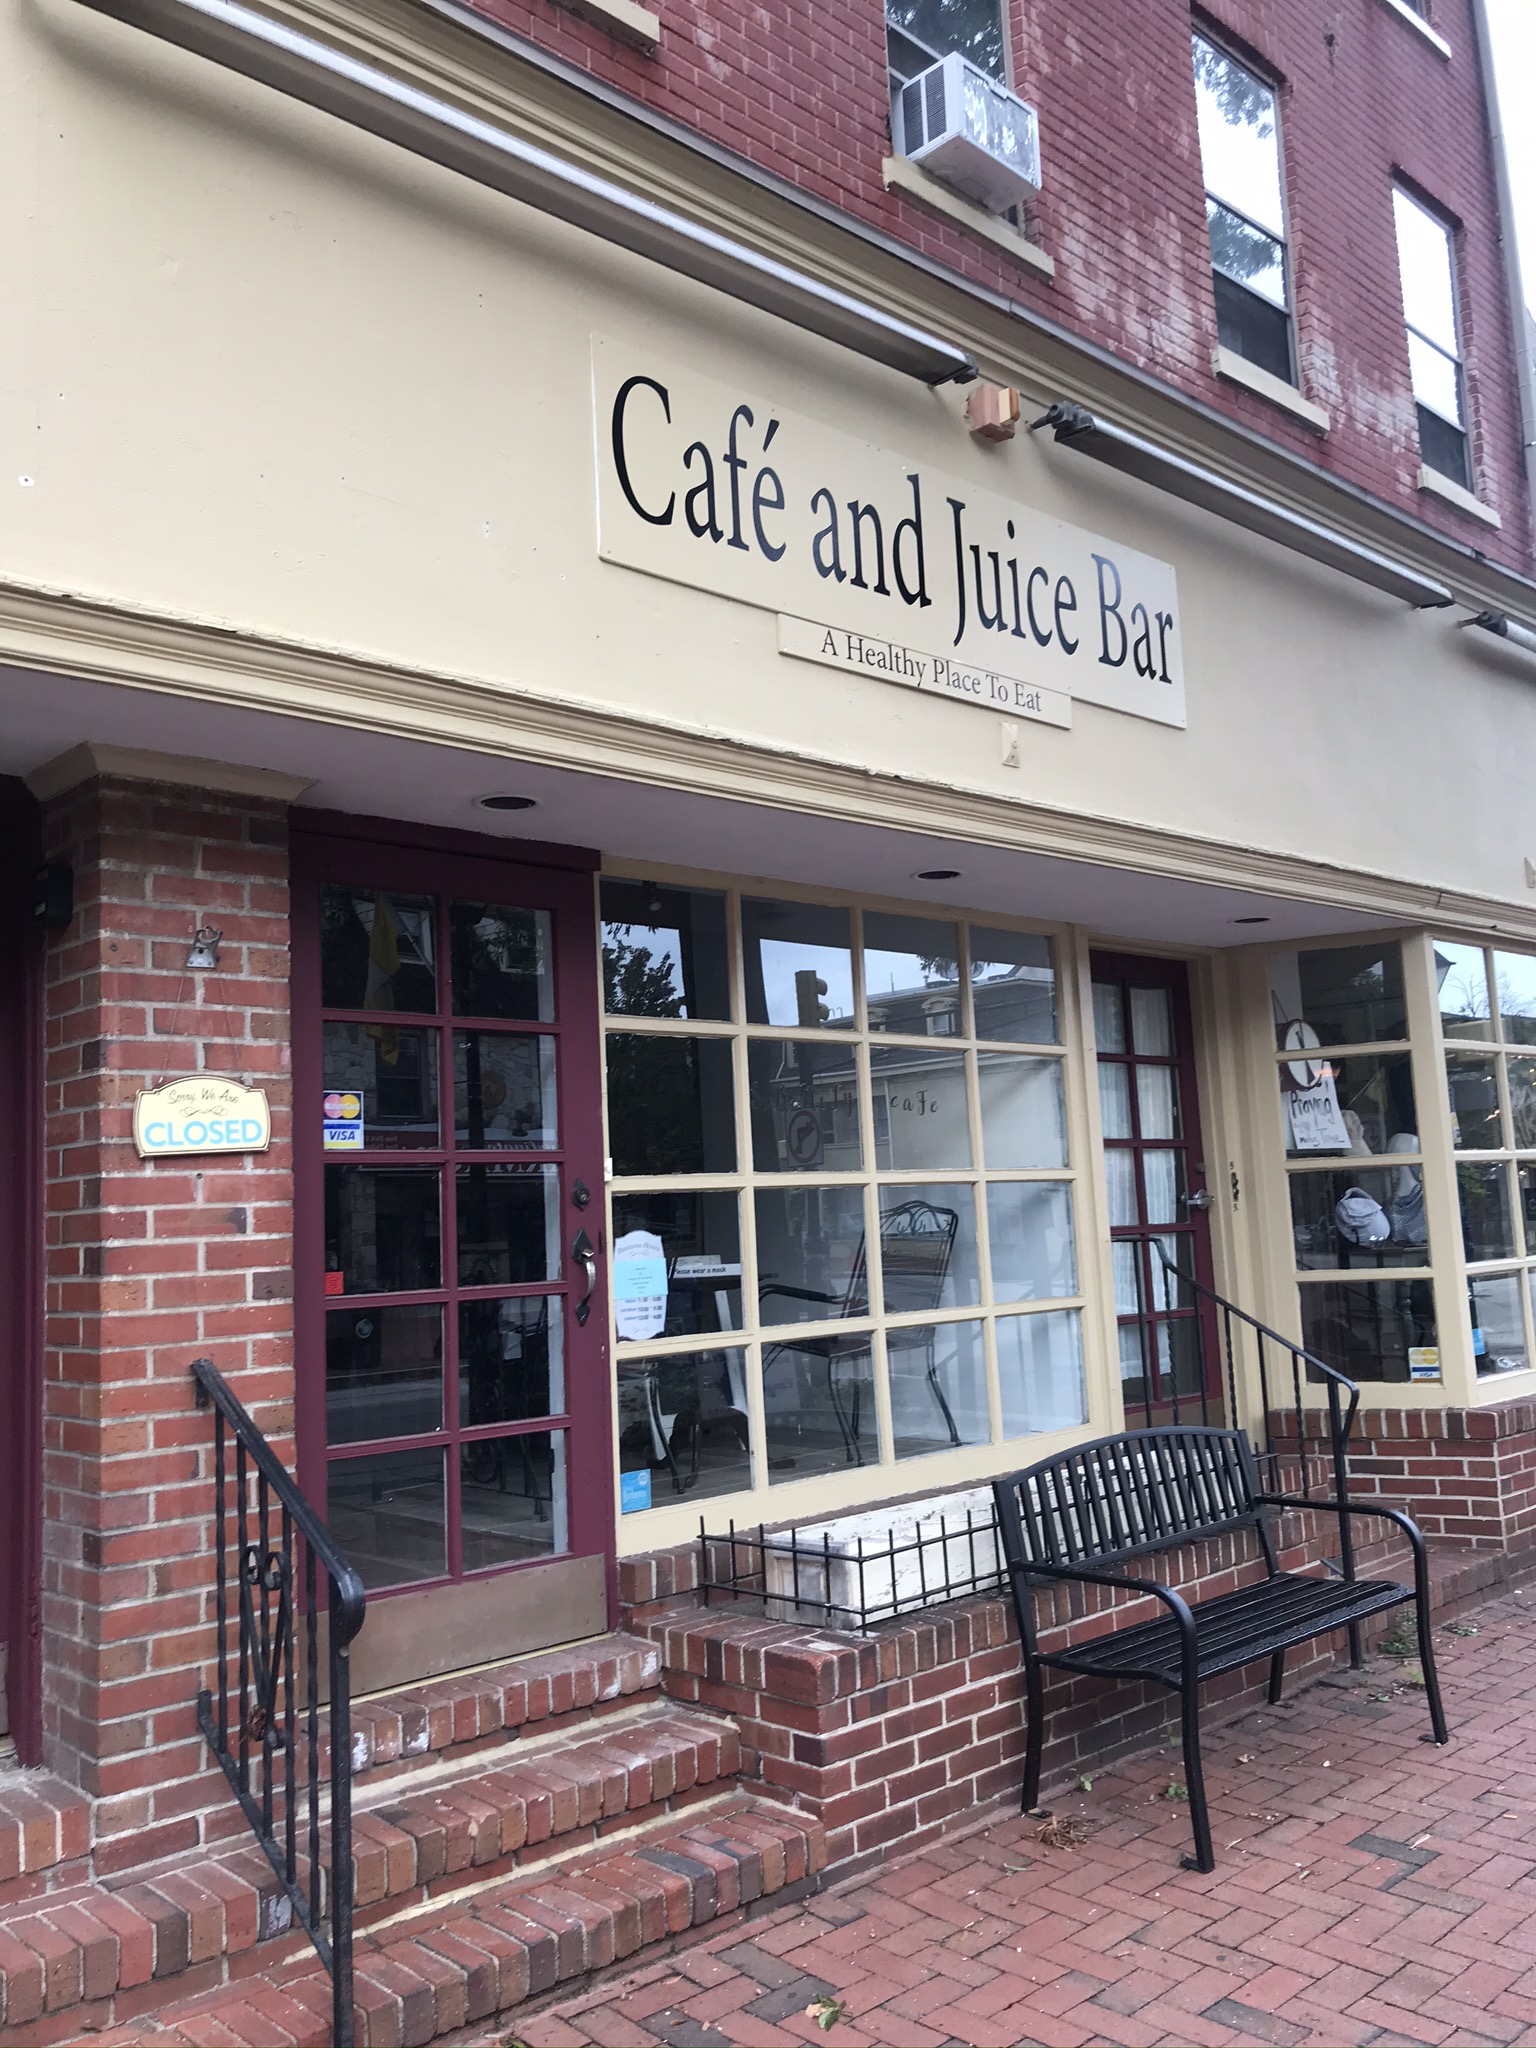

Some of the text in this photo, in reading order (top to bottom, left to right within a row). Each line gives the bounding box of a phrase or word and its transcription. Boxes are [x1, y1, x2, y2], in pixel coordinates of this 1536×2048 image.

[612, 376, 1173, 684] Café and Juice Bar
[821, 630, 1042, 712] A Healthy Place To Eat
[167, 1088, 239, 1104] Sorry We Are
[144, 1119, 263, 1147] CLOSED
[329, 1130, 355, 1140] VISA
